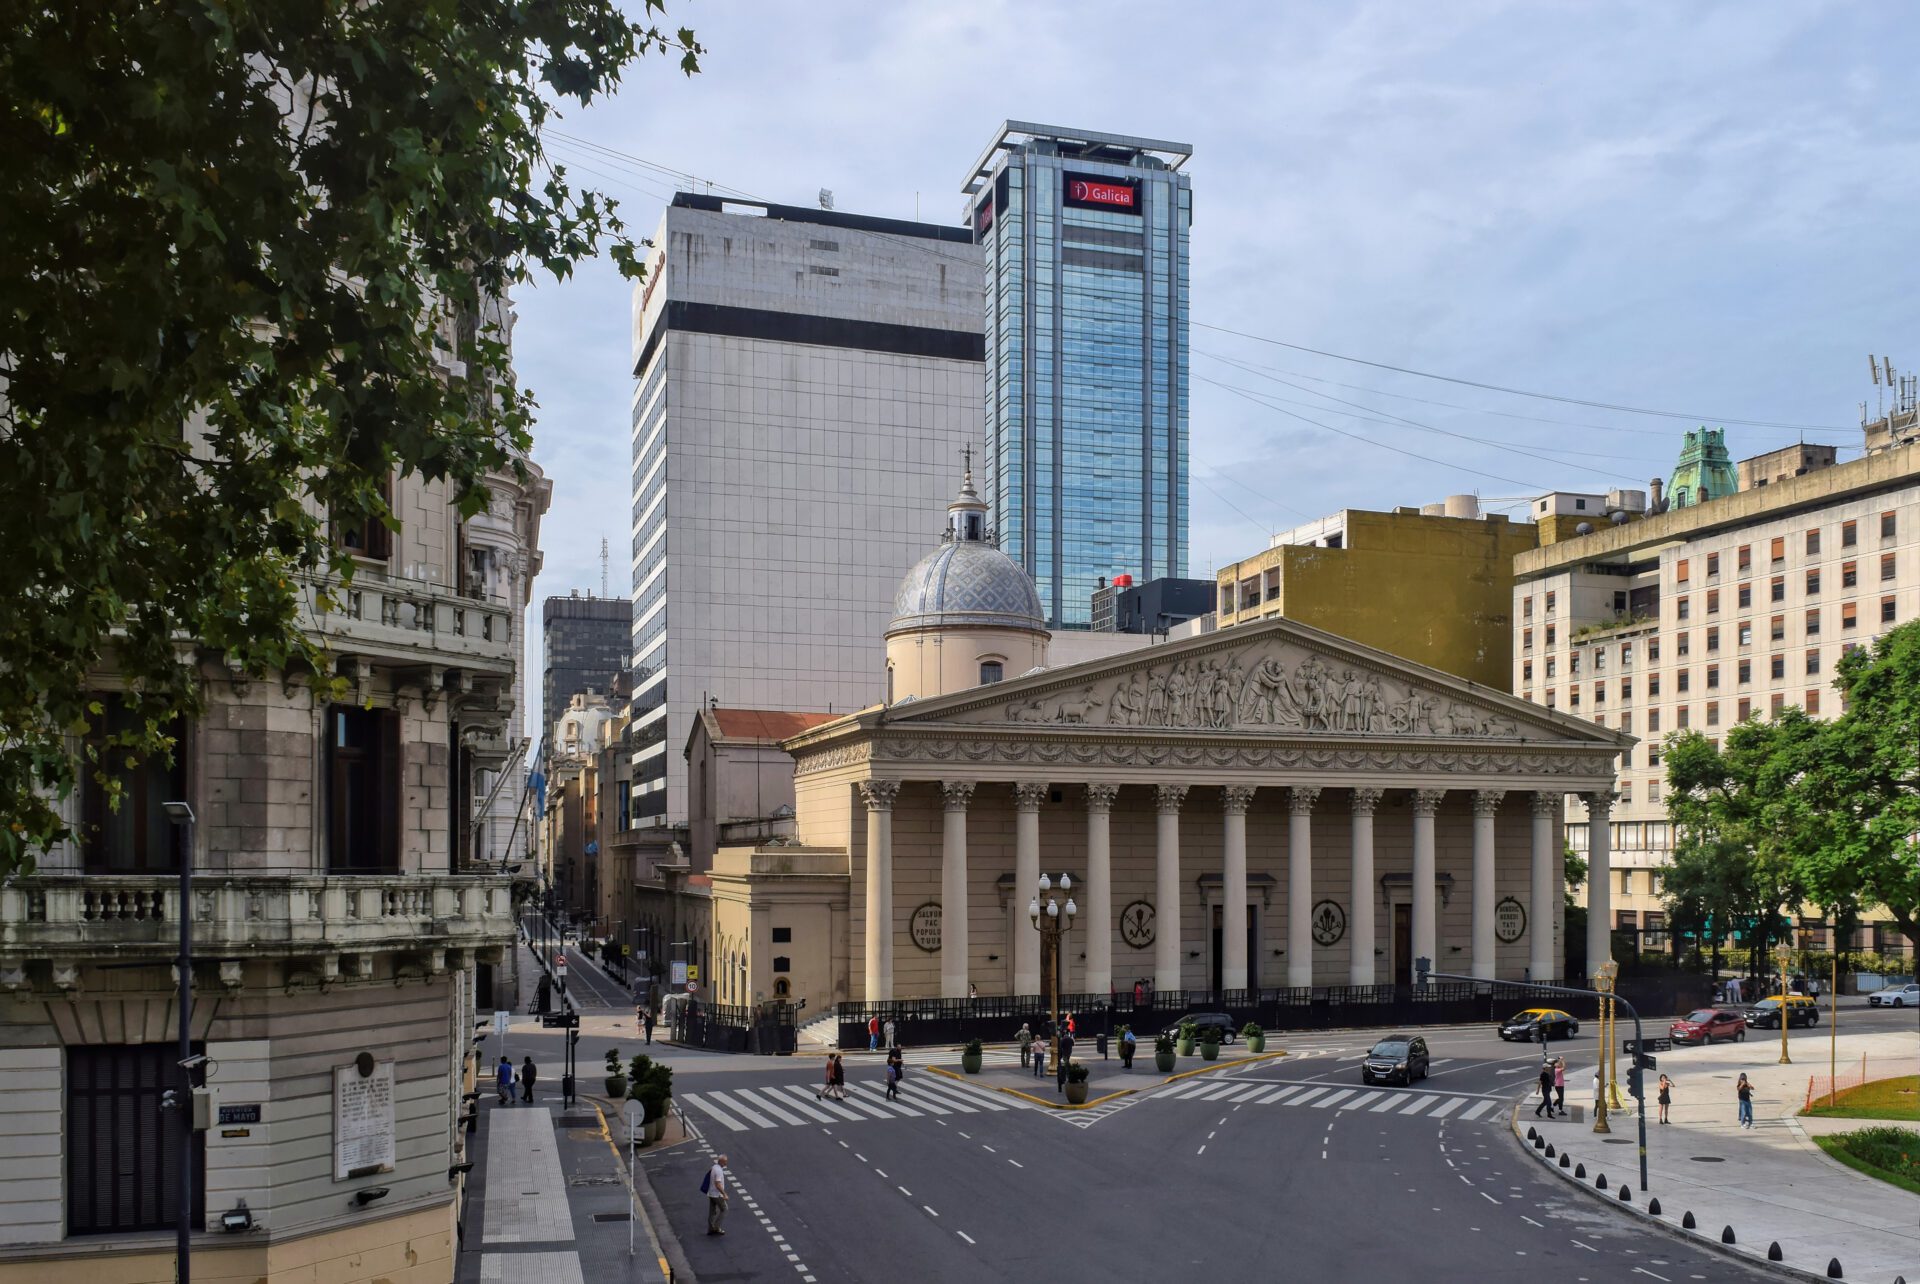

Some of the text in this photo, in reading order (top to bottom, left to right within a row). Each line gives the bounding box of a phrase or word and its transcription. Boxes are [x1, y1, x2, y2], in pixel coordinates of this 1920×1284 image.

[1092, 188, 1130, 203] Galicia
[916, 928, 941, 936] POPULU
[219, 1112, 256, 1121] DE MAYO
